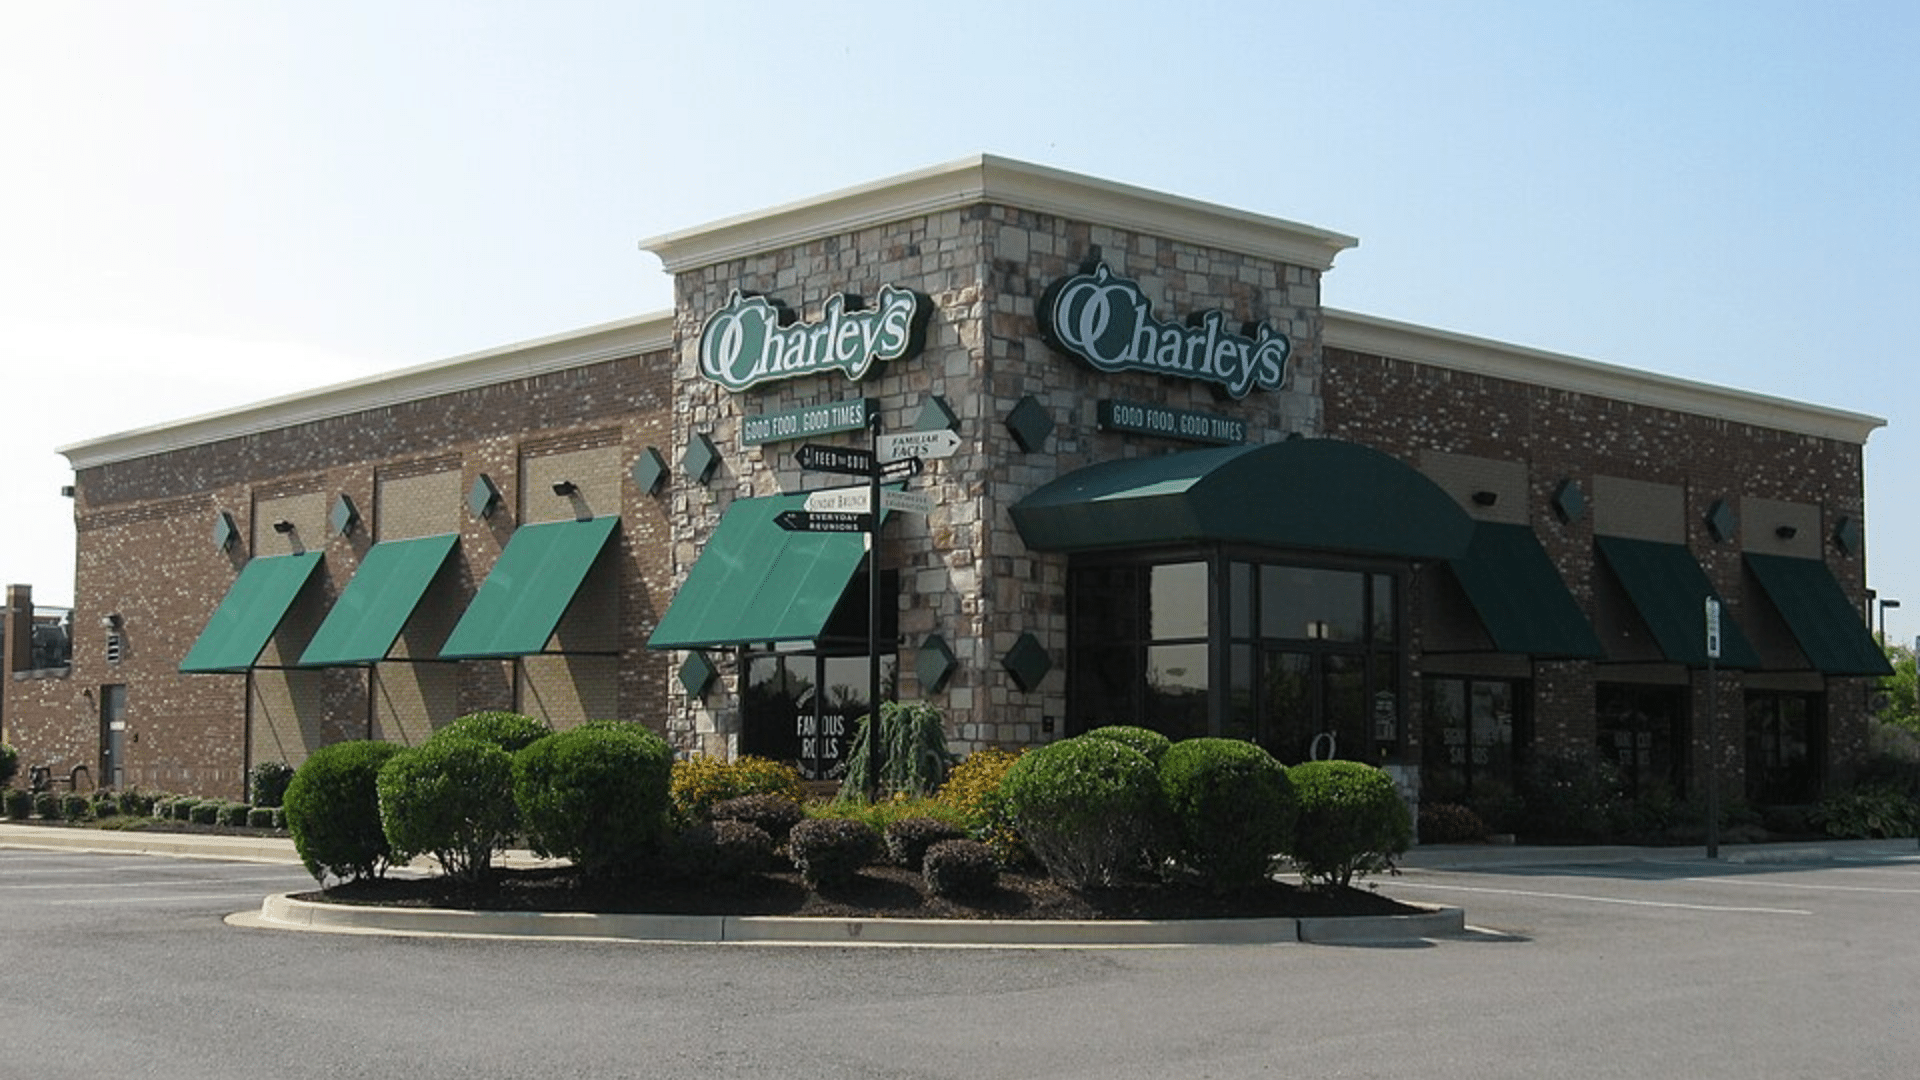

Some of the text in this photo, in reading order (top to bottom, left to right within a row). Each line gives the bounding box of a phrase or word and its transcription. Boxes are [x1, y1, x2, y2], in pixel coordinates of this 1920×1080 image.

[745, 420, 770, 441] GOOD
[803, 409, 829, 431] GOOD
[831, 404, 863, 426] TIMES
[1113, 405, 1144, 428] GOOD
[1180, 414, 1209, 436] GOOD
[1211, 419, 1243, 442] TIMES
[892, 444, 929, 458] FACES
[809, 513, 858, 521] EVERYDAY
[809, 522, 859, 531] REUNIONS
